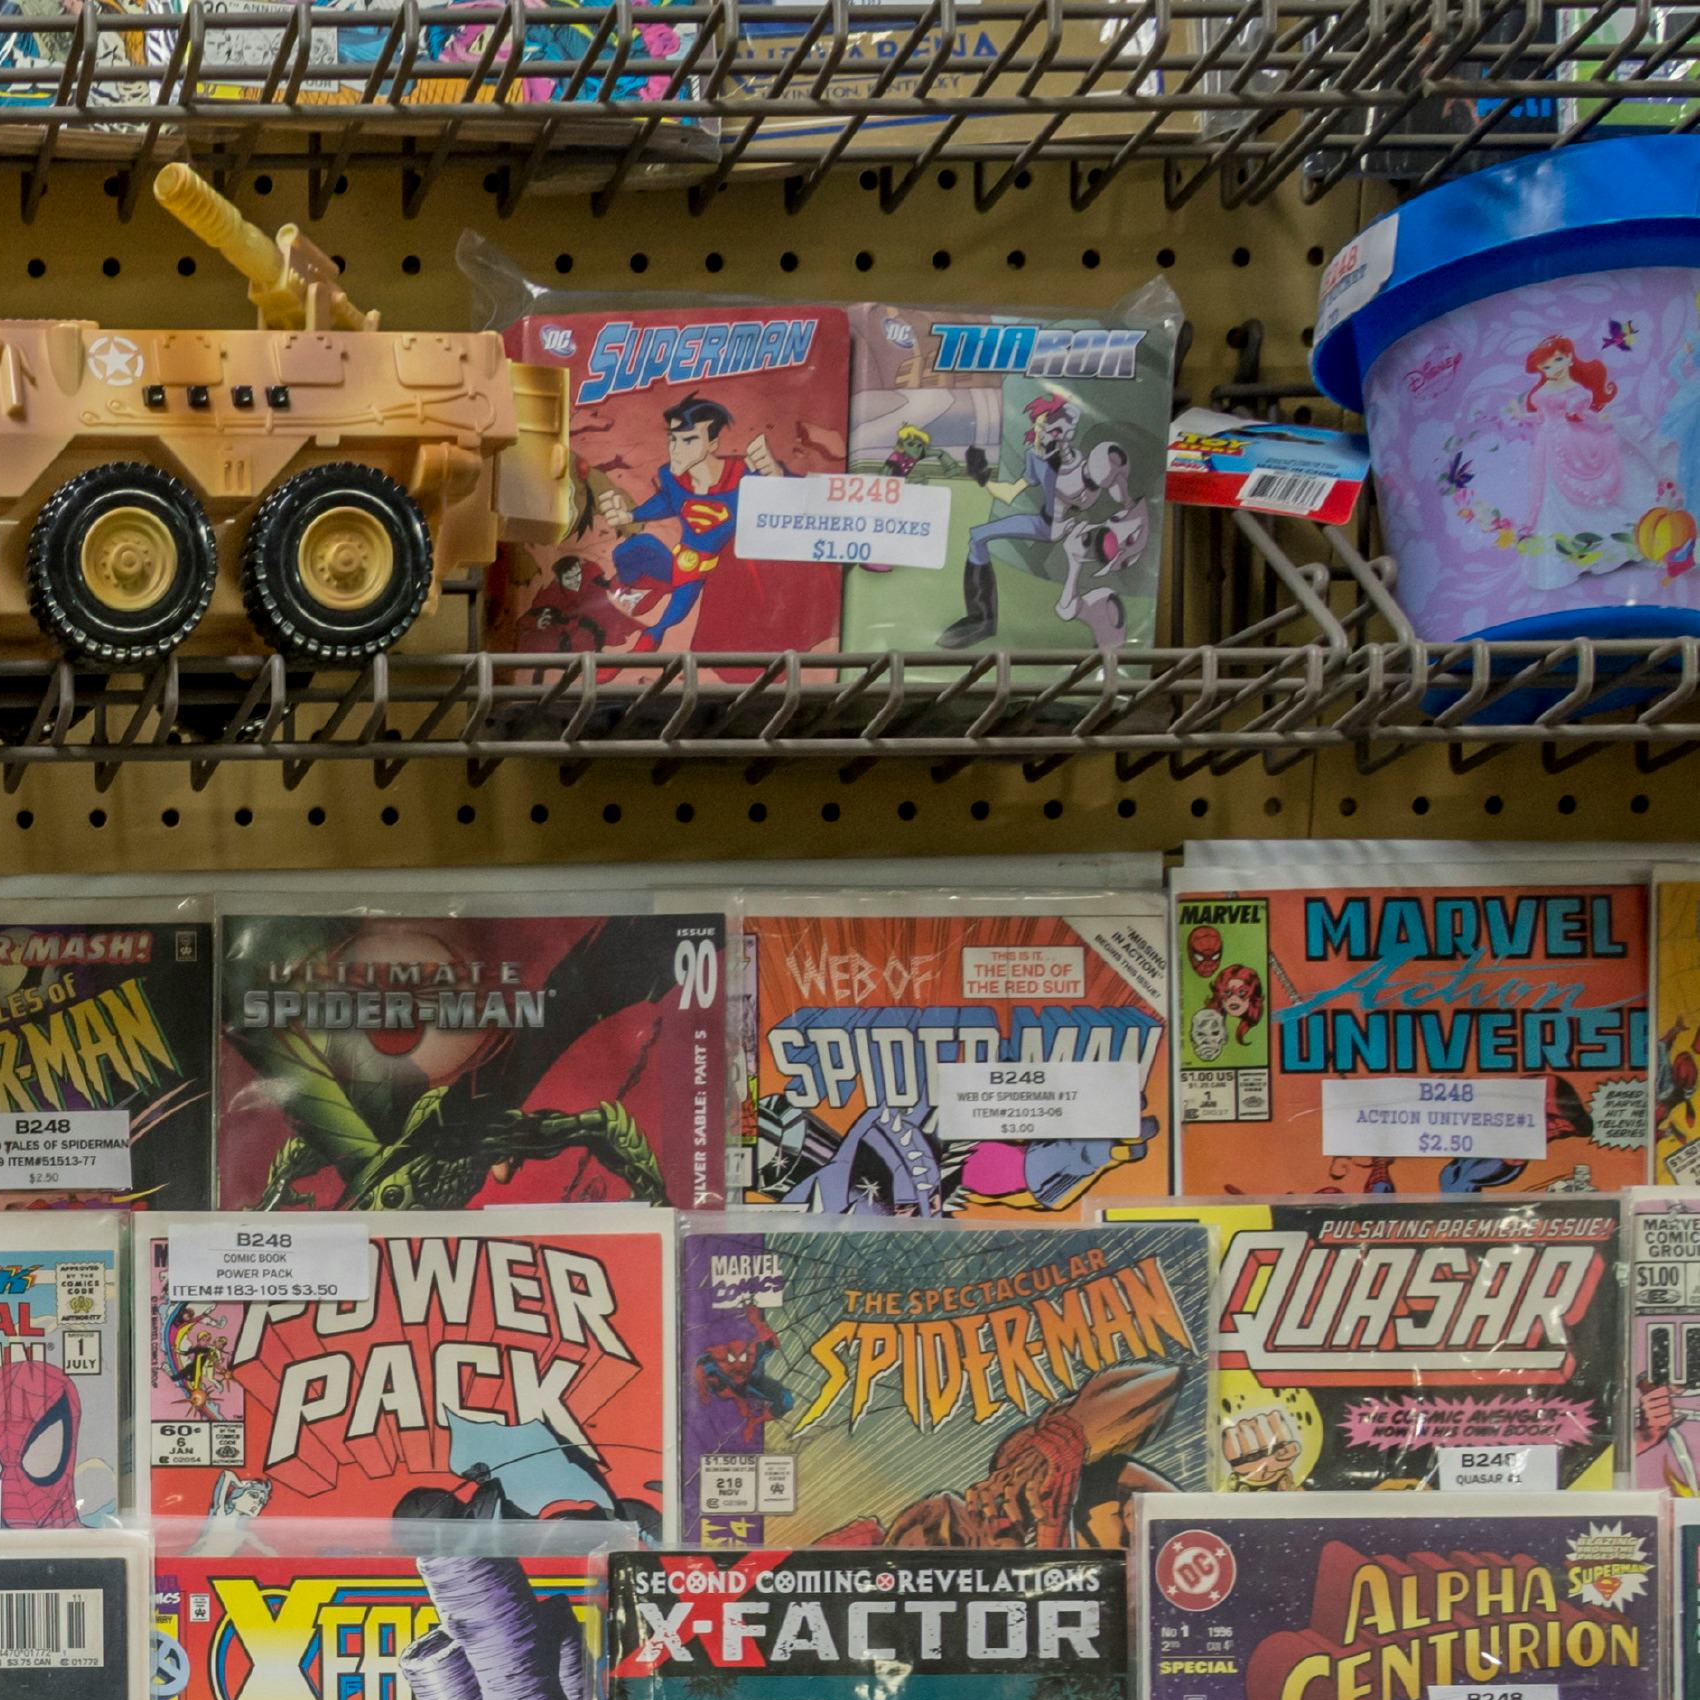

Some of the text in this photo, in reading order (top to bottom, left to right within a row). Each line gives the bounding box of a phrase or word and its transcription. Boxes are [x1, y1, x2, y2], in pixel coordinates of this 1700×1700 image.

[577, 321, 814, 403] SUPERMAN
[828, 477, 900, 503] B248
[756, 514, 930, 536] SUPERHERO BOXES
[812, 539, 871, 561] $1.00
[1305, 897, 1626, 959] MARVEL
[990, 1070, 1046, 1086] B248
[1420, 1083, 1472, 1102] B248
[1002, 1124, 1034, 1133] $3.00
[1357, 1110, 1536, 1128] ACTION UNIVERSE#1
[1419, 1134, 1472, 1154] $2.50
[236, 1233, 291, 1248] B248
[217, 1270, 293, 1279] POWER PACK
[1221, 1231, 1600, 1373] QUASAR
[1344, 1565, 1556, 1644] ALPHA
[639, 1600, 1102, 1664] X-FACTOR
